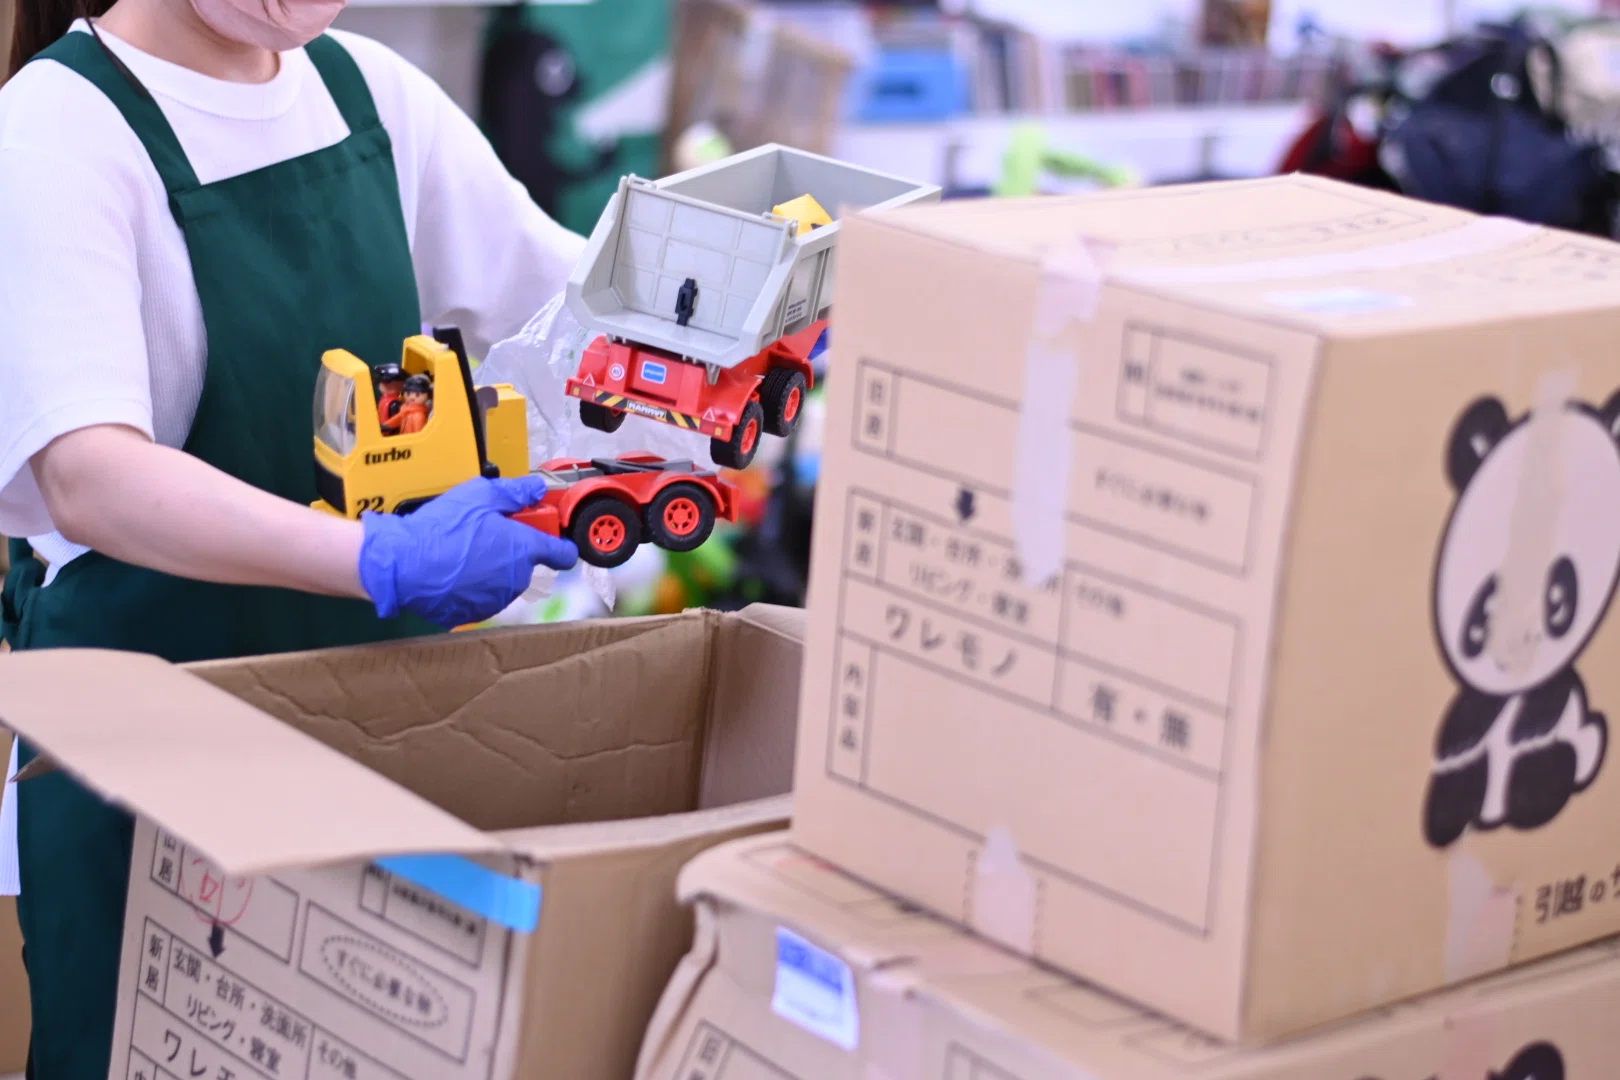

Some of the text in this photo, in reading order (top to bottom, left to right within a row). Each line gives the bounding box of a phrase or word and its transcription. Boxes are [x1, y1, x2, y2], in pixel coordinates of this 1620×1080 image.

[364, 446, 412, 466] turbo
[356, 496, 385, 520] 22
[885, 603, 1019, 677] ワレモノ
[145, 934, 164, 992] 新居
[187, 994, 281, 1074] リビング・寝室
